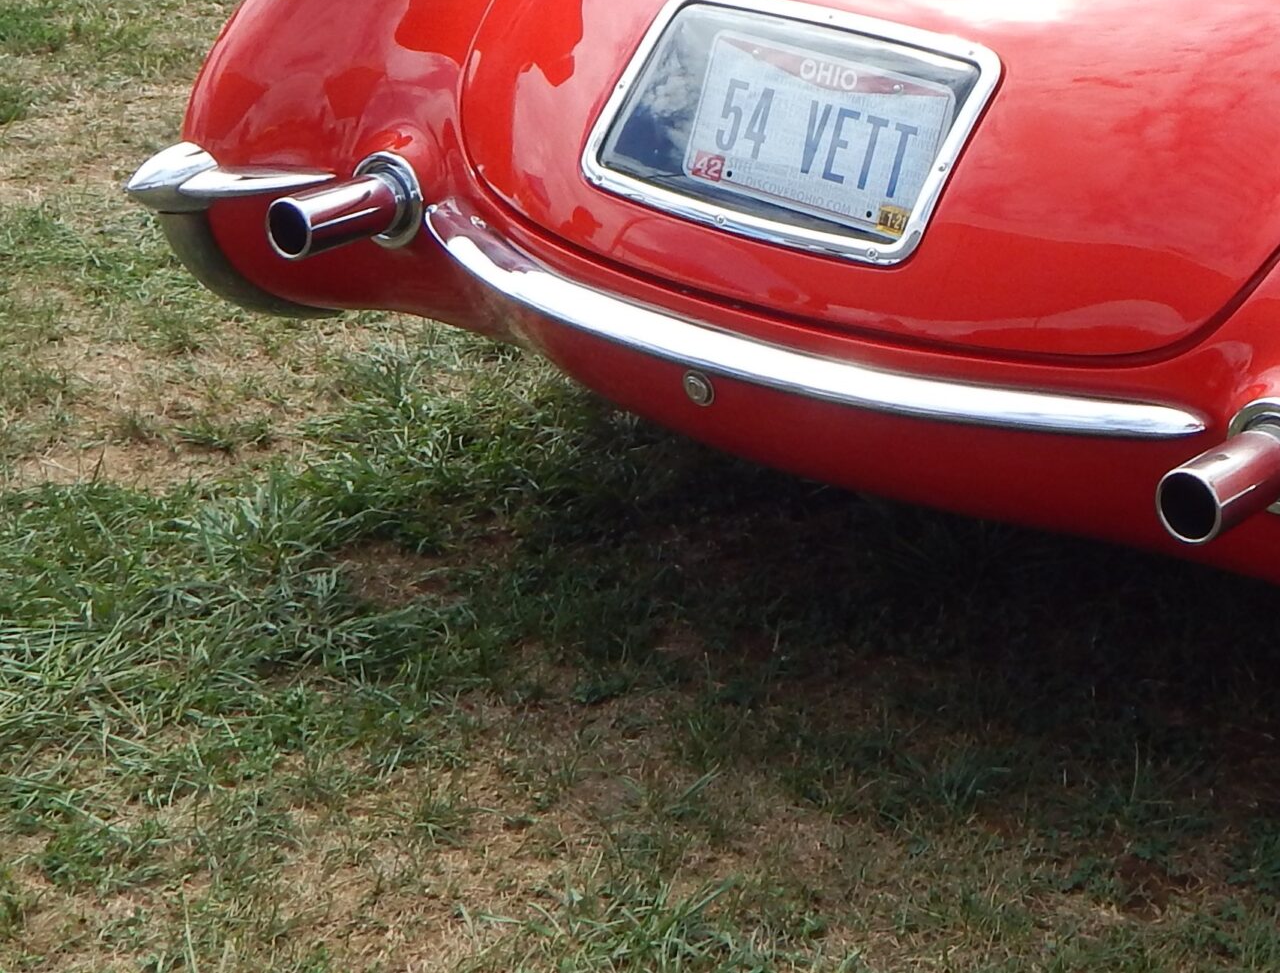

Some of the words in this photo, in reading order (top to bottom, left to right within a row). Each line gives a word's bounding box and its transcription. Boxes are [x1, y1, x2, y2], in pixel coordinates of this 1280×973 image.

[800, 59, 858, 90] OHIO
[715, 78, 775, 160] 54
[800, 99, 919, 198] VETT
[695, 153, 723, 177] 42
